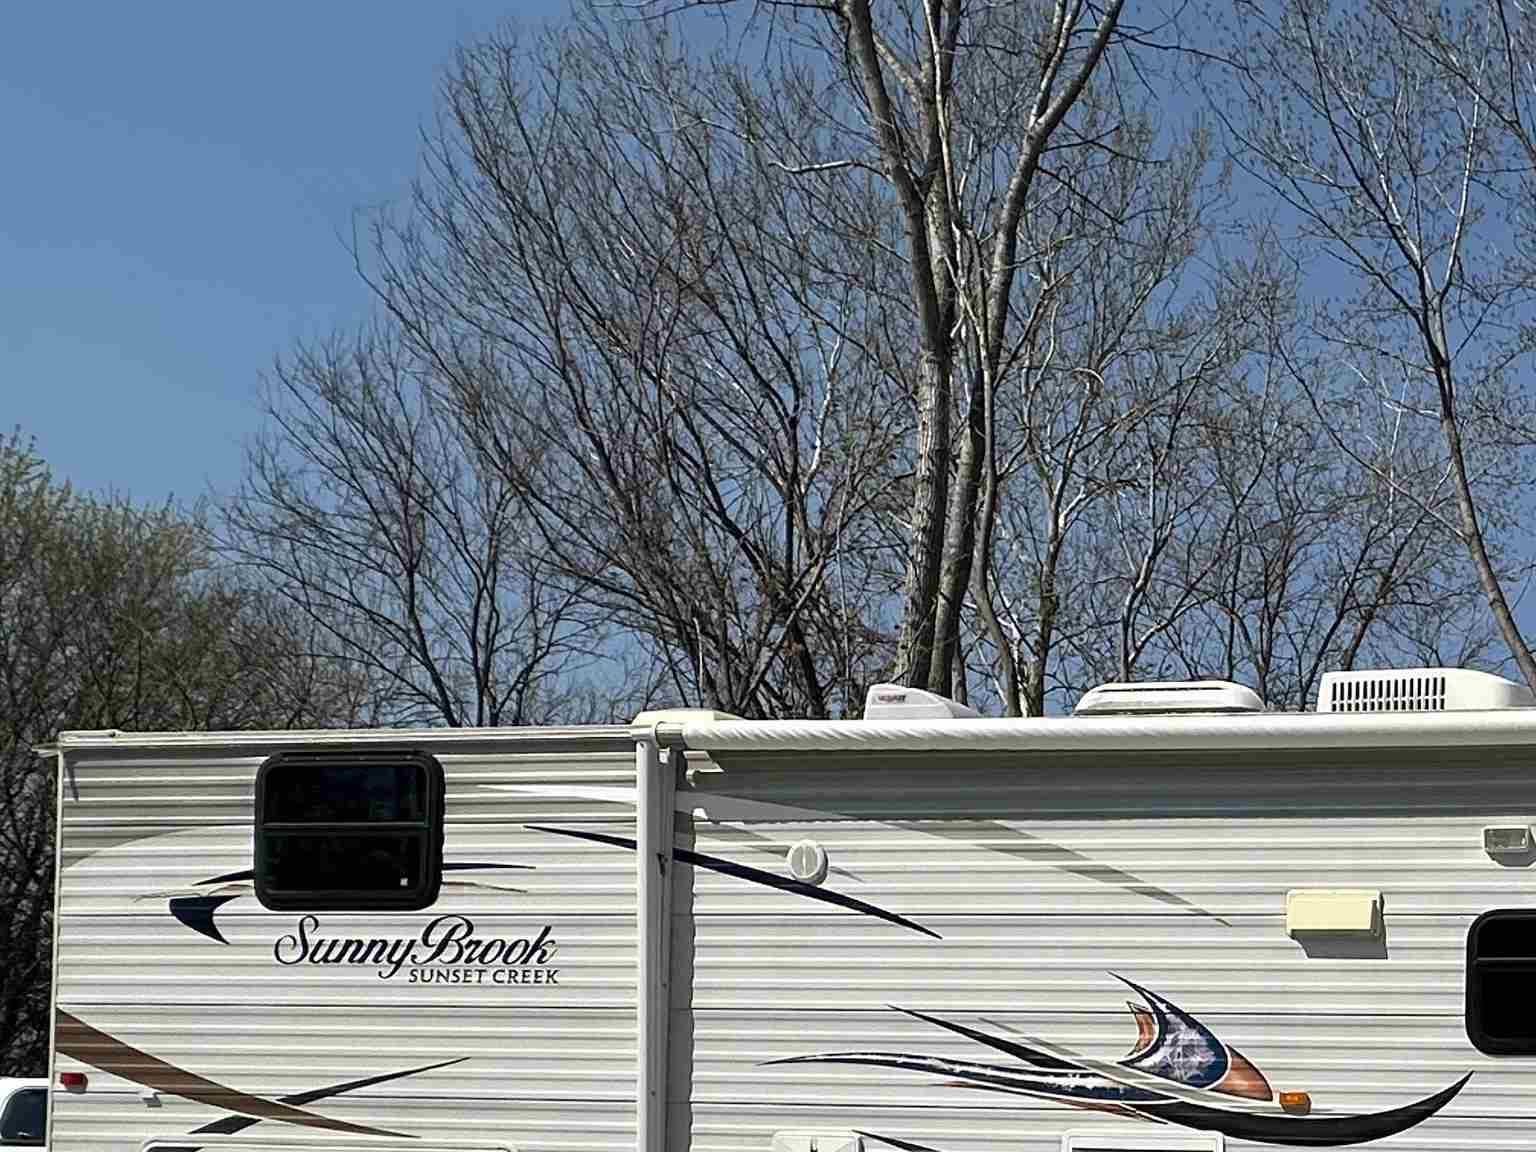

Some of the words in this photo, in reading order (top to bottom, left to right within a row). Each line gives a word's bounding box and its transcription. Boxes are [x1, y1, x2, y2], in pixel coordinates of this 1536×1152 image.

[275, 914, 556, 979] SunnyBrook
[408, 968, 487, 984] SUNSET
[492, 969, 560, 985] CREEK
